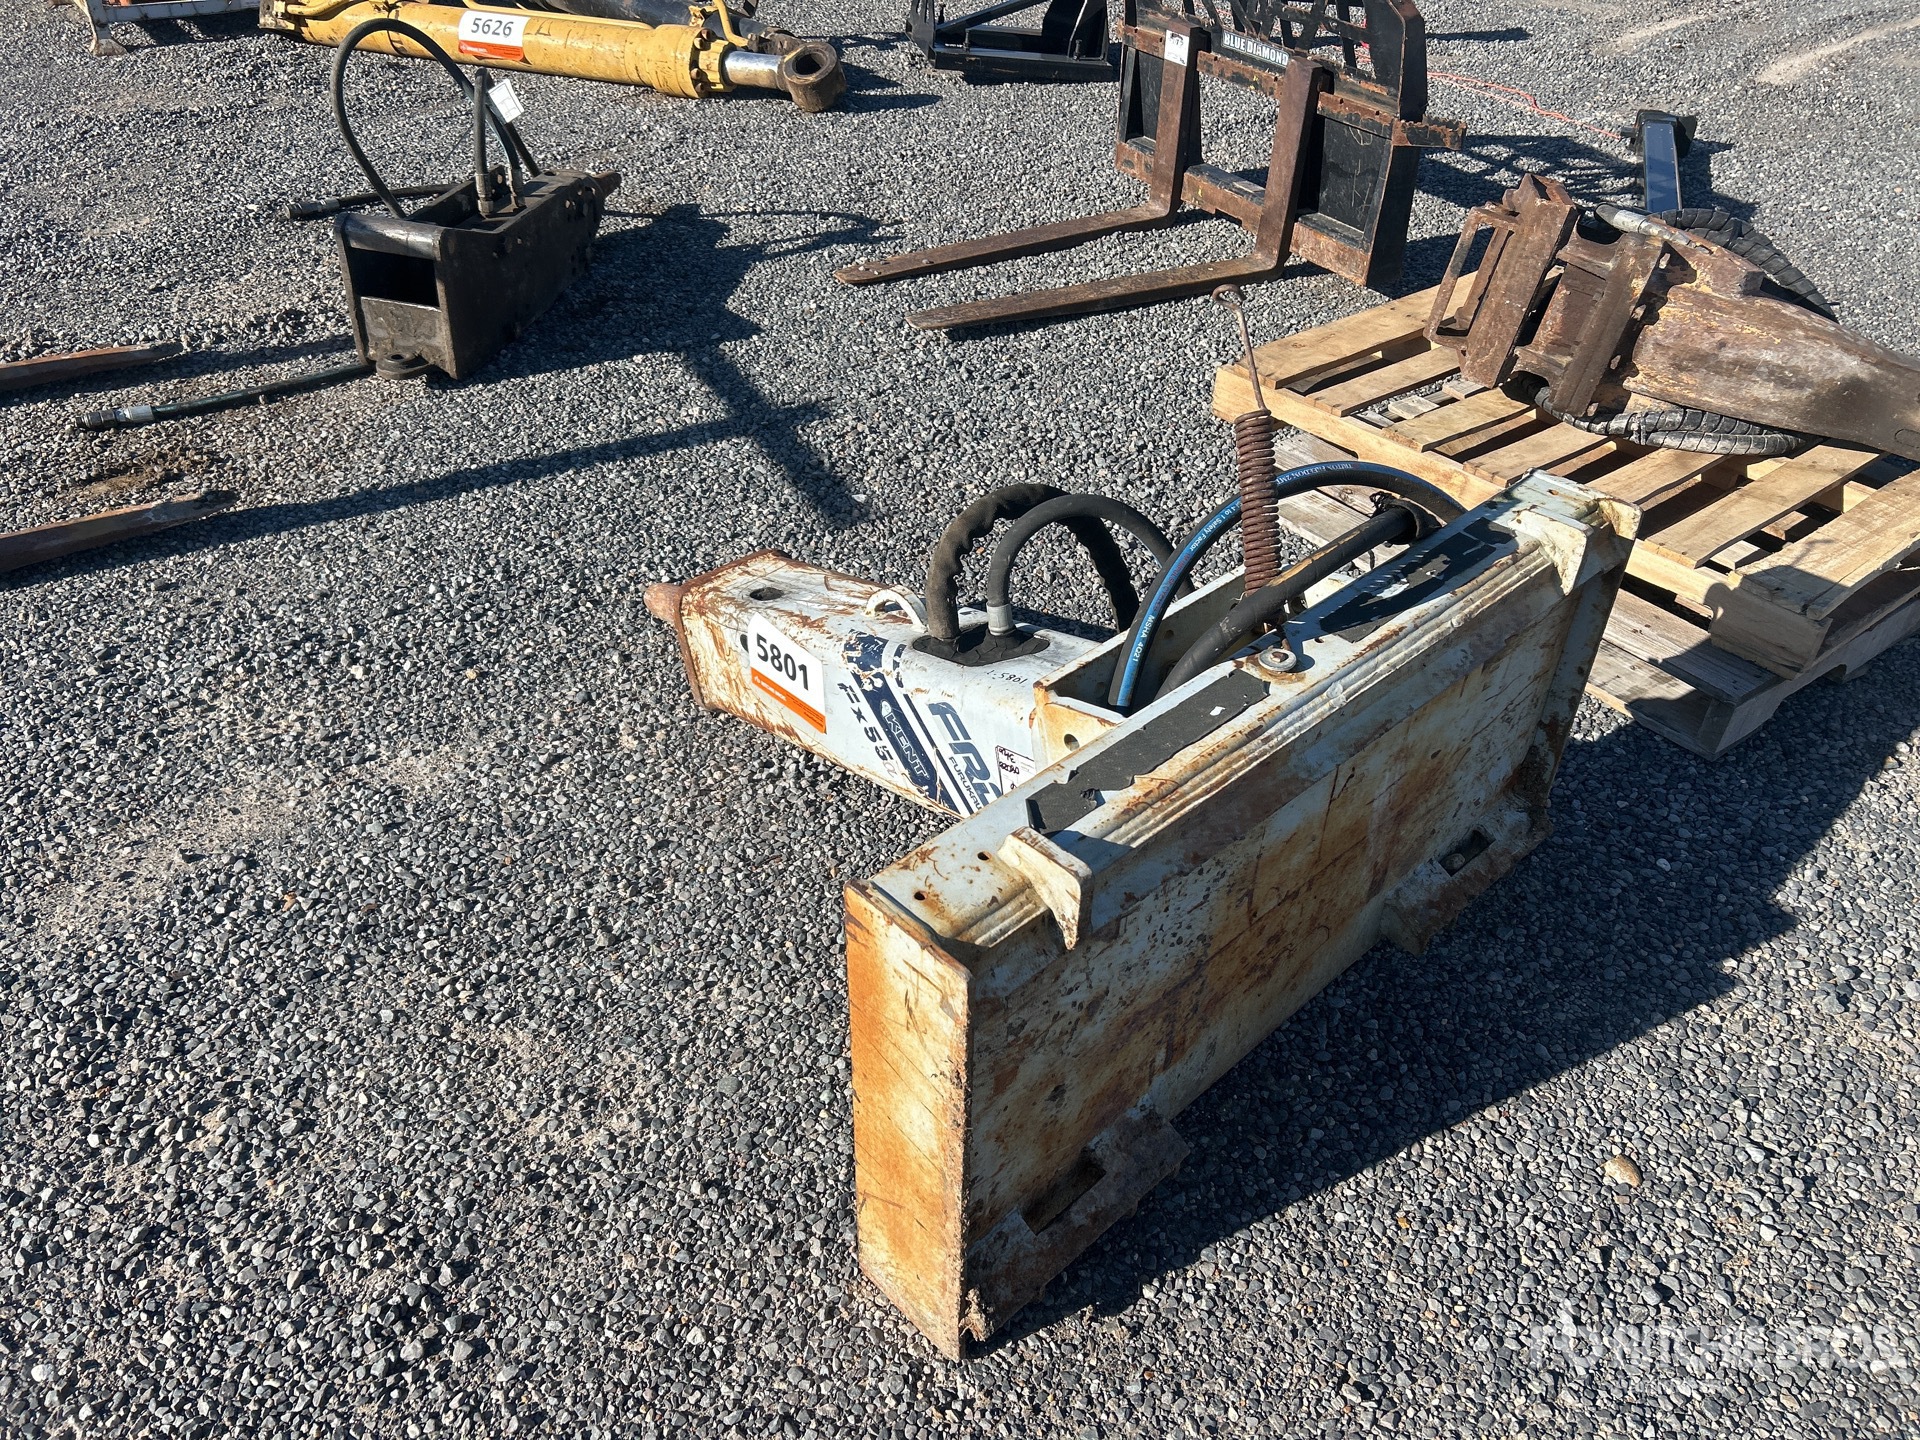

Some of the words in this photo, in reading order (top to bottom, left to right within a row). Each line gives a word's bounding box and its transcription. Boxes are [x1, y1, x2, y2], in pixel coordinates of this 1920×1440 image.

[471, 17, 514, 37] 5626
[1223, 31, 1246, 52] BLUE
[1246, 39, 1290, 66] DIAMOND
[1202, 517, 1223, 534] Safety
[1189, 533, 1208, 552] Factor
[1140, 614, 1156, 638] MSHA
[756, 632, 809, 691] 5801
[1132, 641, 1145, 663] 4Q21
[884, 711, 929, 779] KENT
